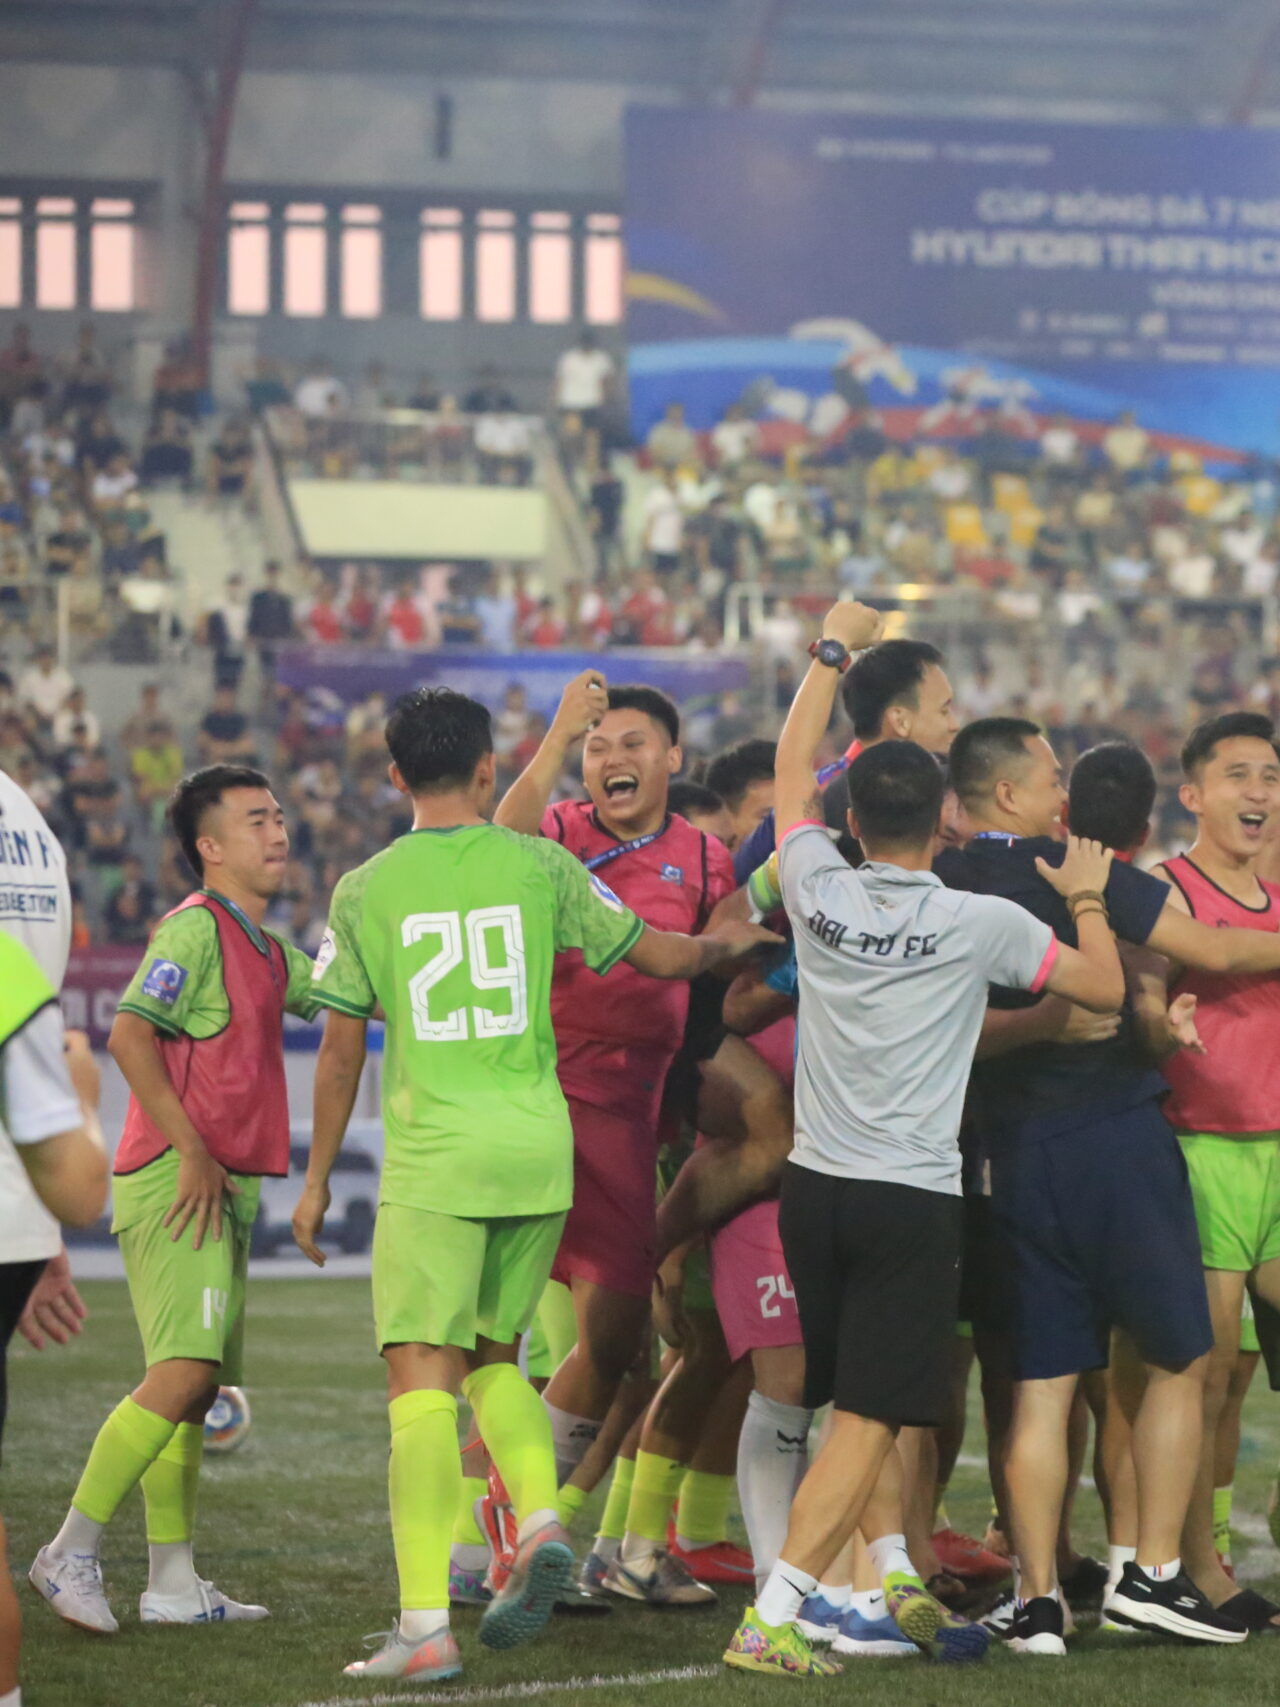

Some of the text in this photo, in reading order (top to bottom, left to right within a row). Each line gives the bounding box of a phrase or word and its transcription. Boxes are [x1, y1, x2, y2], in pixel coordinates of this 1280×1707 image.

[911, 229, 1103, 267] HYUNDAI
[902, 932, 938, 959] FC
[401, 905, 528, 1041] 29
[756, 1273, 799, 1318] 24
